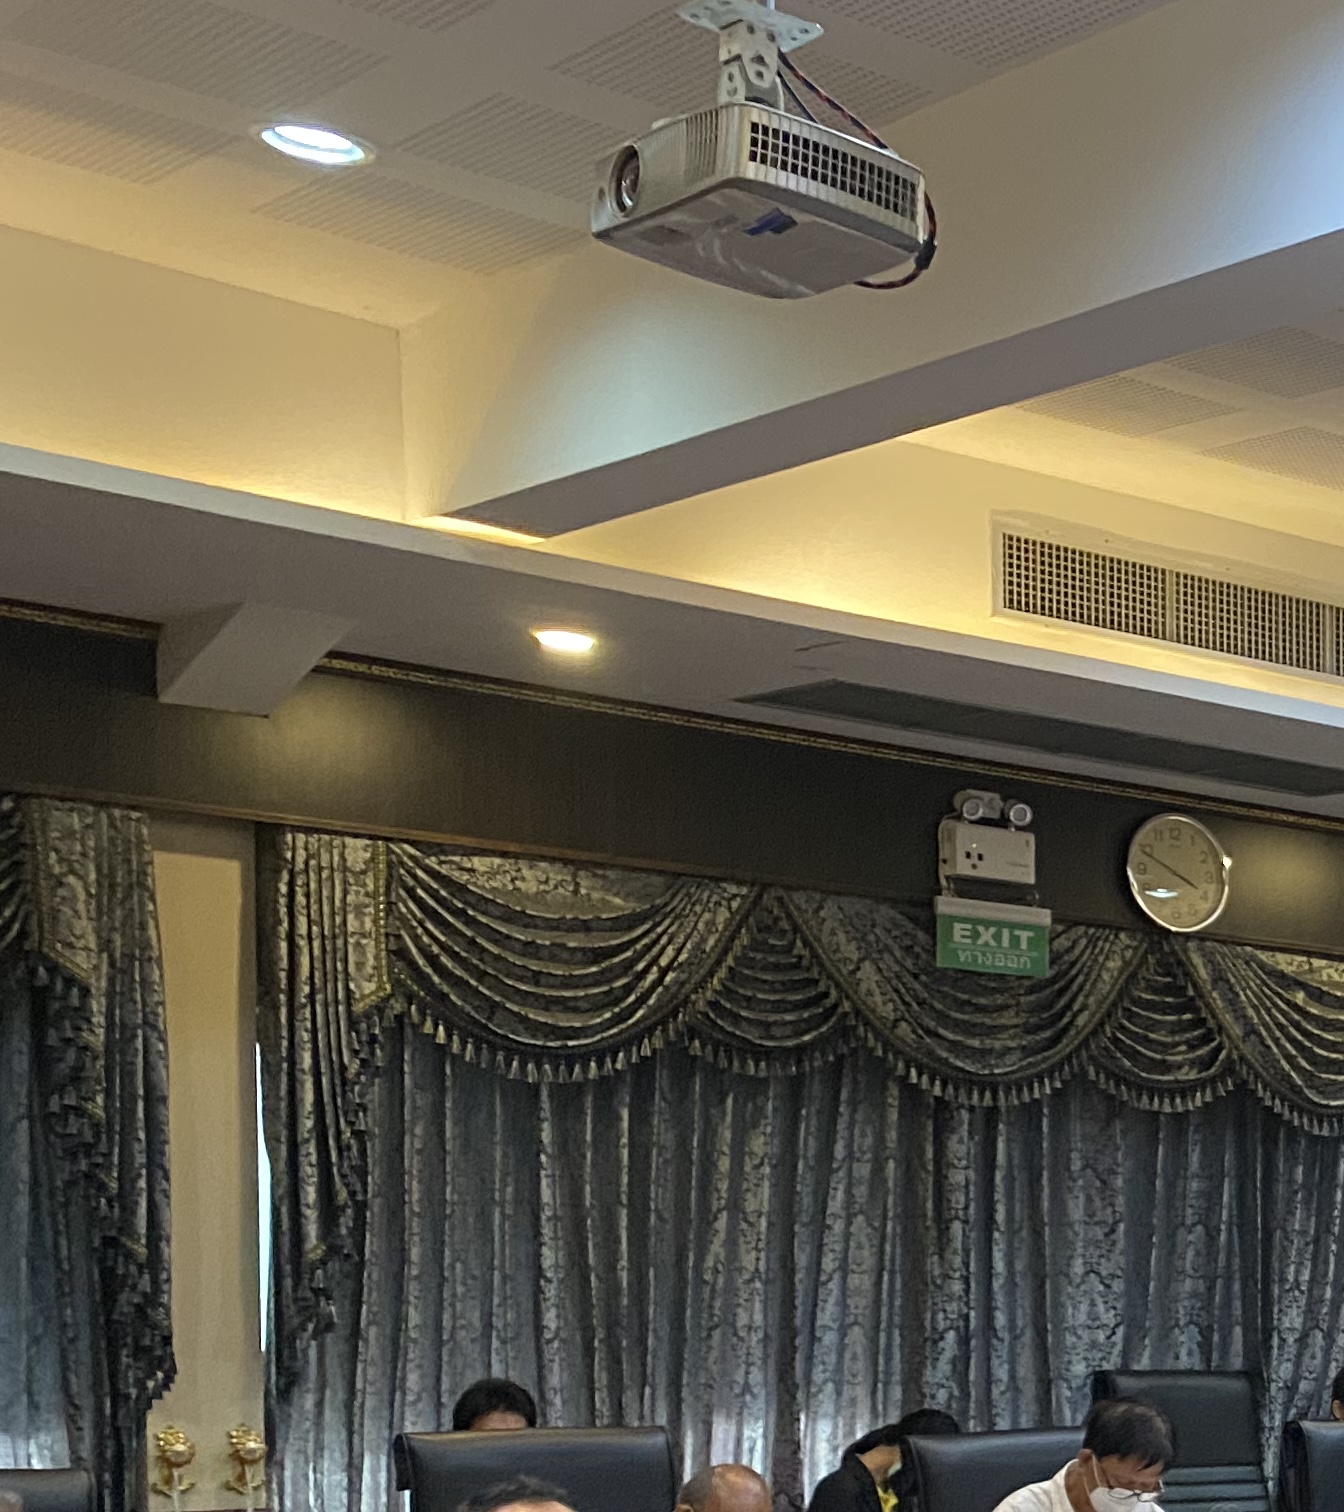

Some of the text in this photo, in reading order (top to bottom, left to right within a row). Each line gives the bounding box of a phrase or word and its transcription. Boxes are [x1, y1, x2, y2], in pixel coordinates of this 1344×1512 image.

[1168, 827, 1181, 841] 12
[952, 922, 1035, 951] EXIT
[956, 950, 1031, 970] ทางออก
